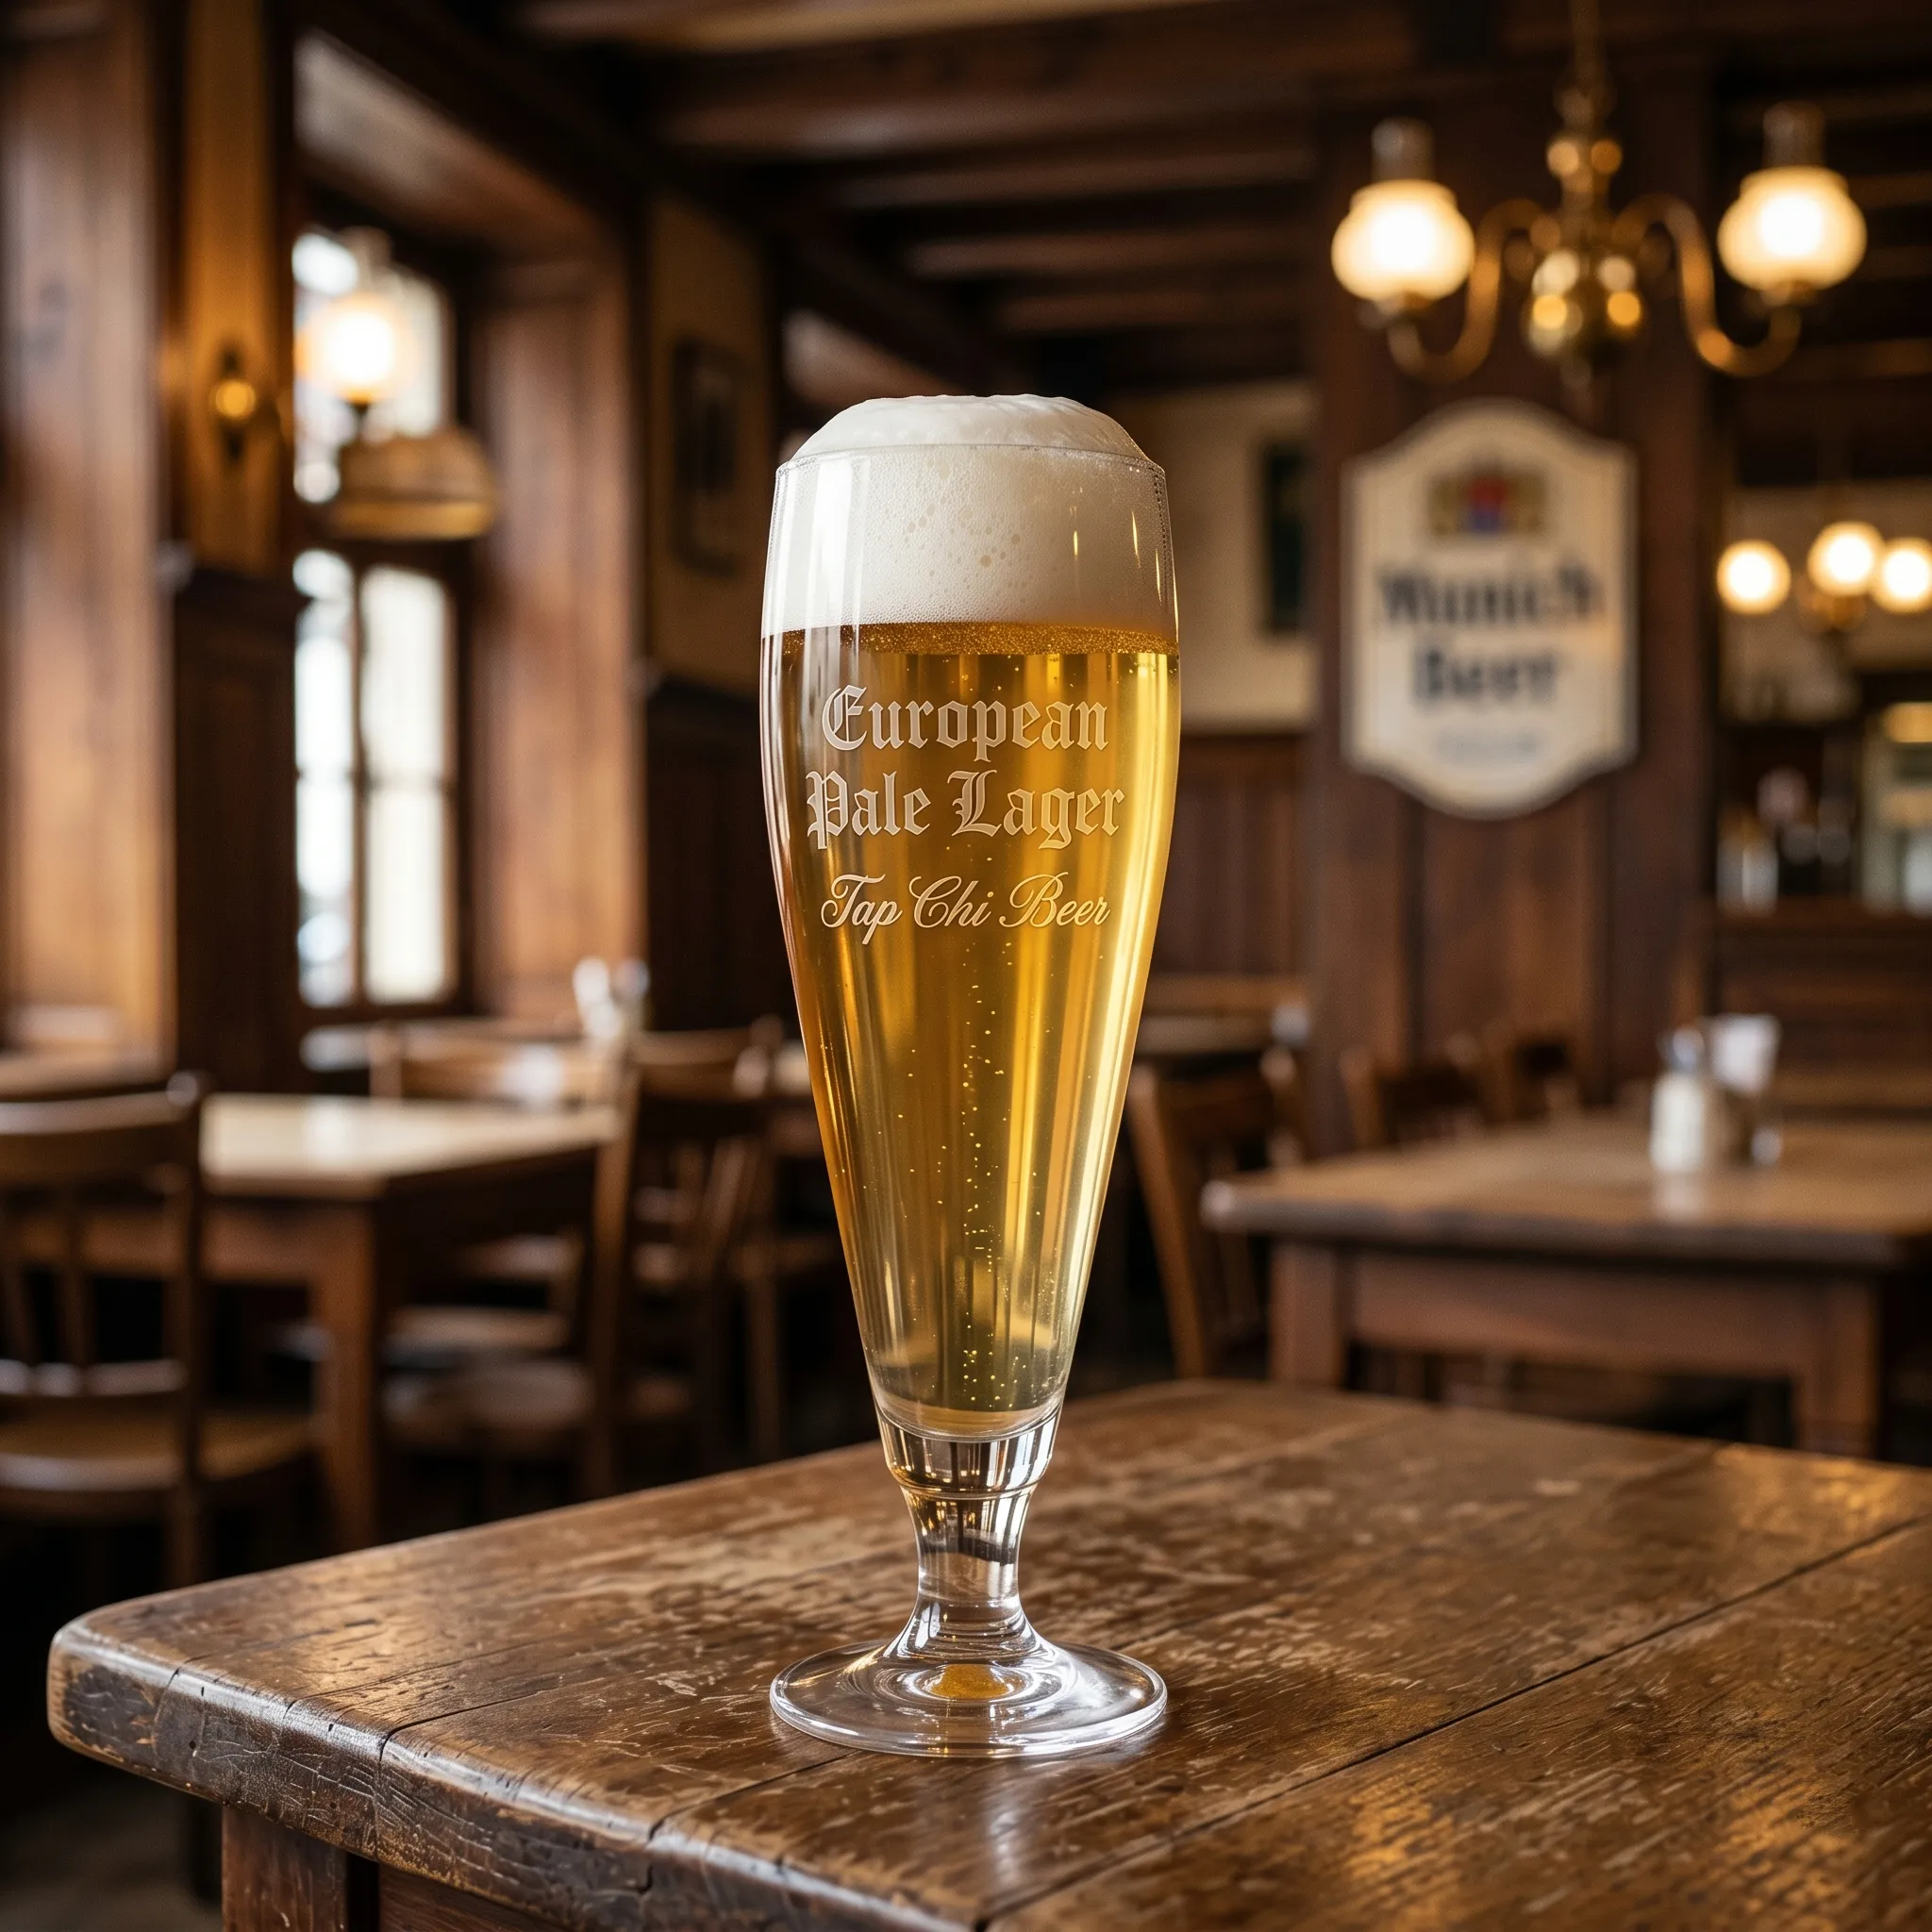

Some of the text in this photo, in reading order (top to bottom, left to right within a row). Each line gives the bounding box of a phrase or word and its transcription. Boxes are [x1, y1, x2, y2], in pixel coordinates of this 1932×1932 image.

[822, 684, 1109, 762] European
[806, 770, 1125, 850] Pale Lager
[821, 872, 1110, 945] Tap Chi Beer
